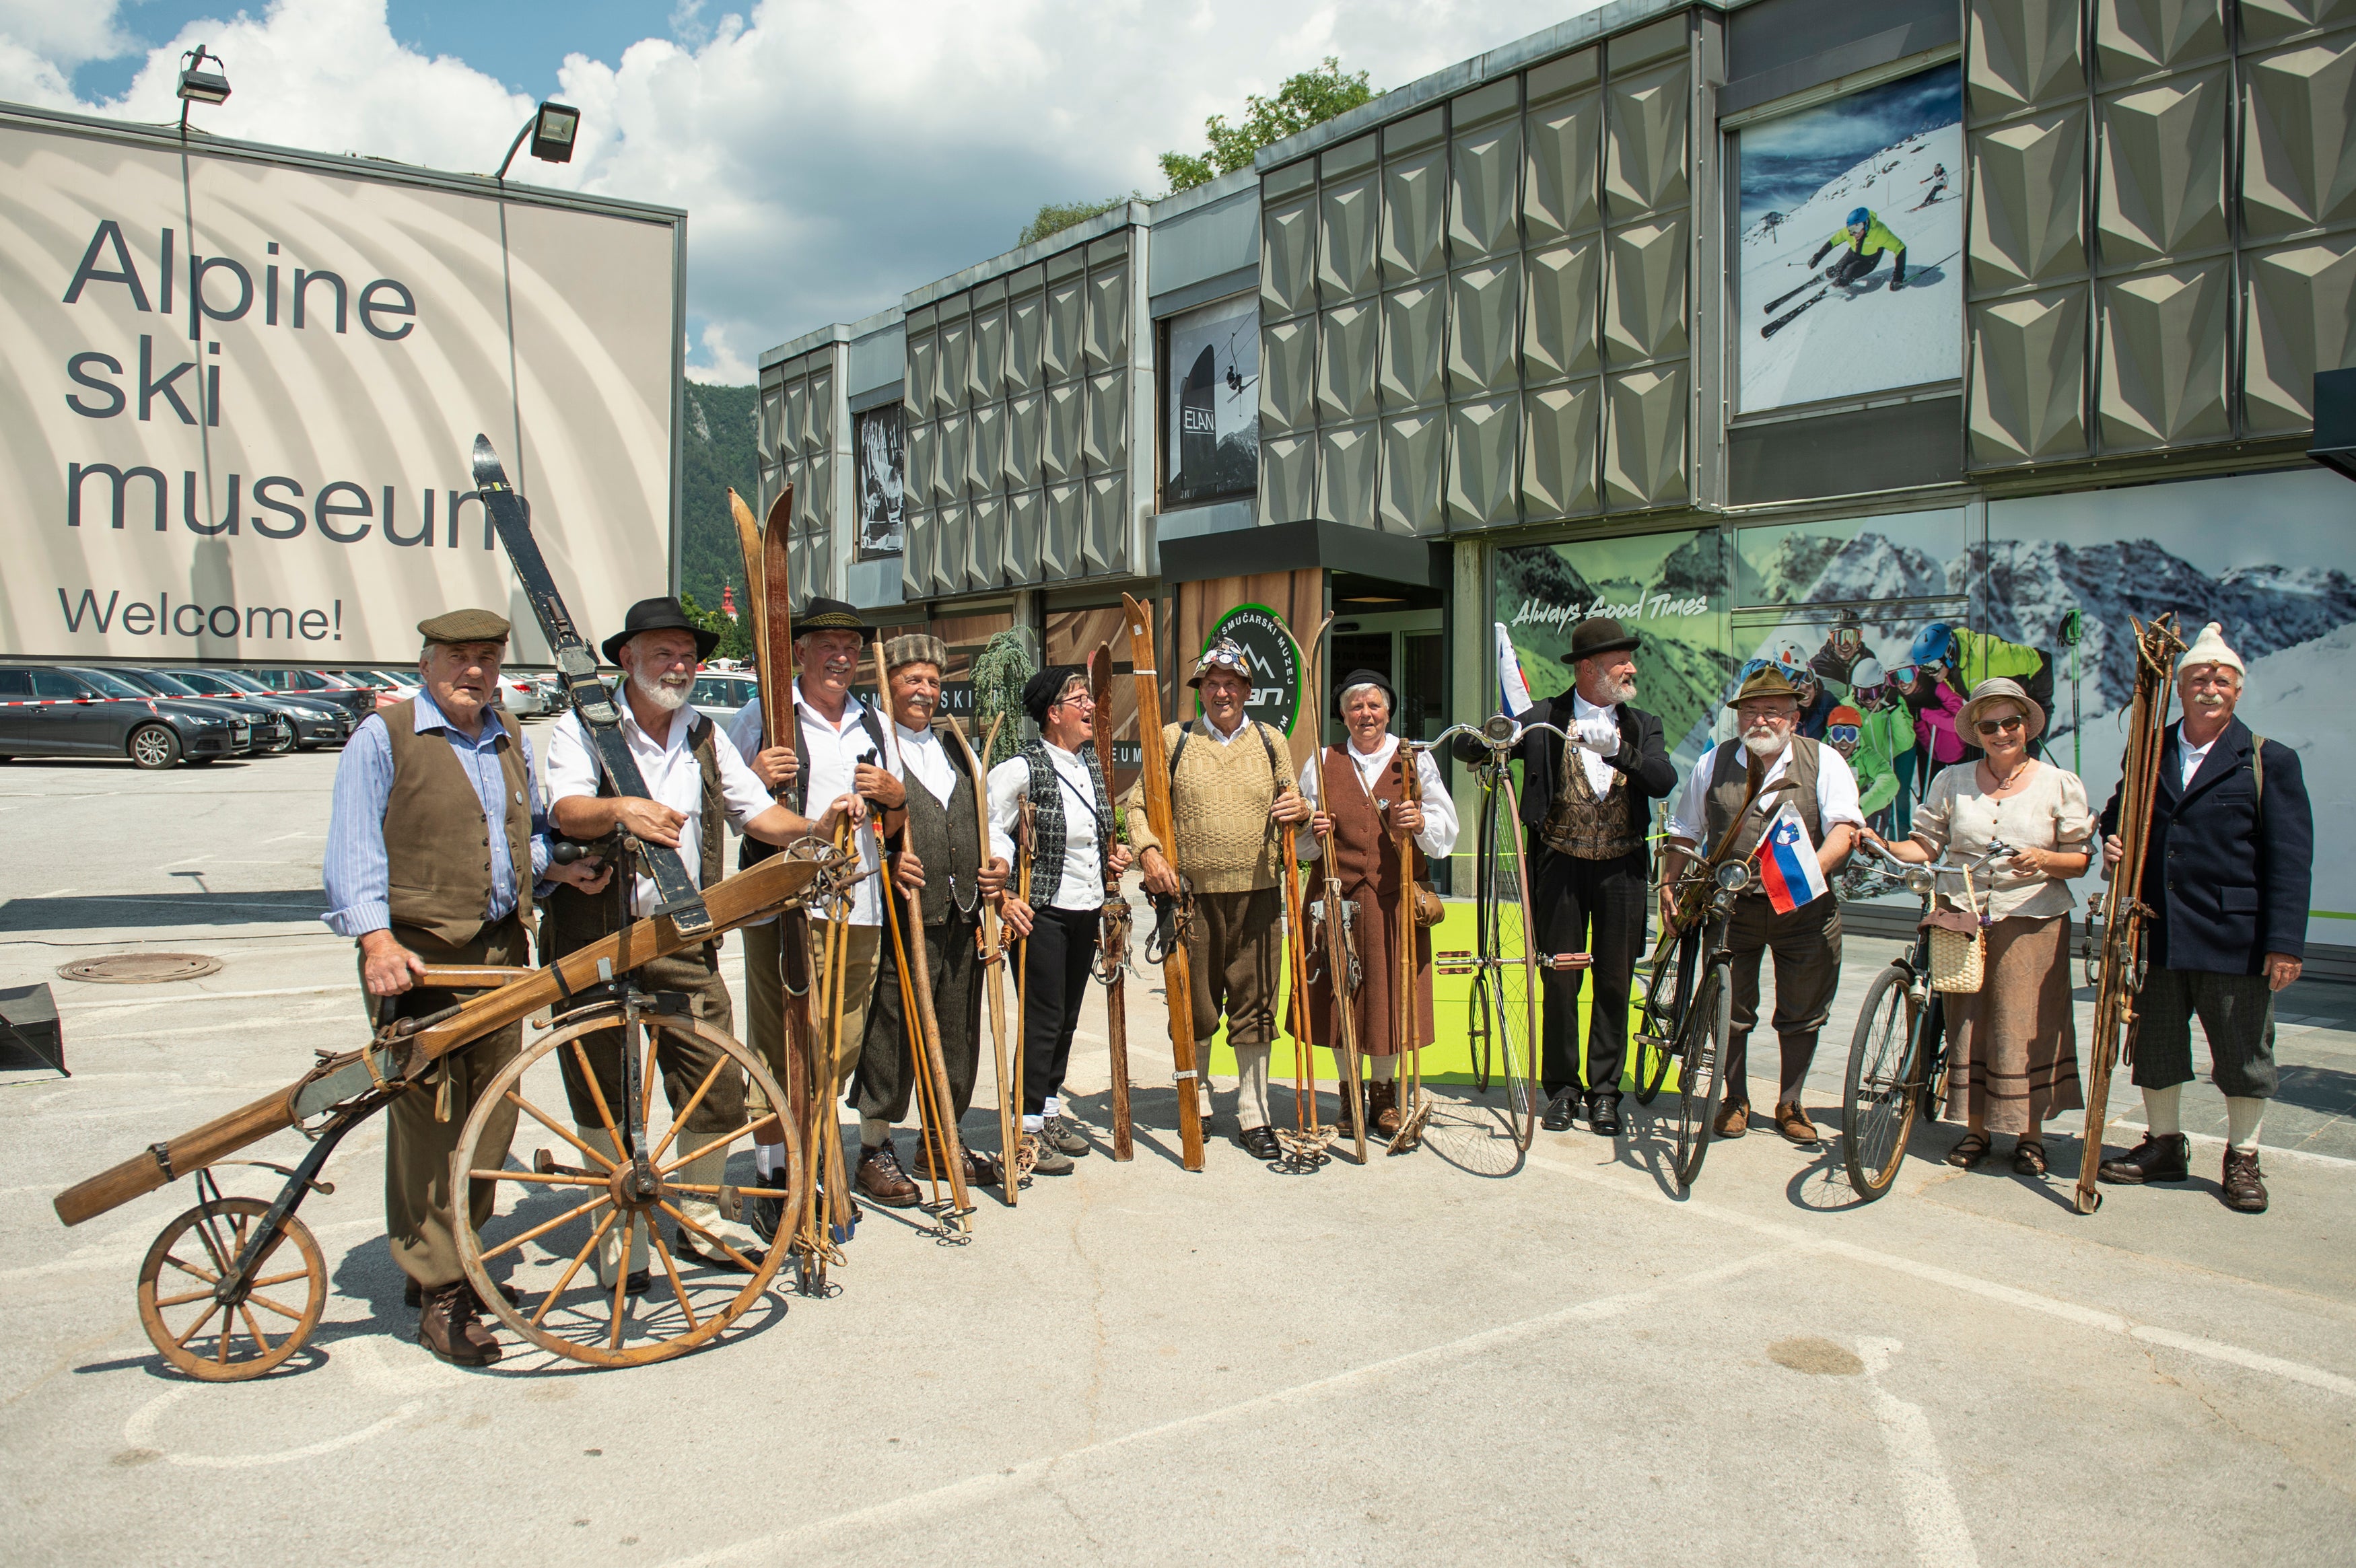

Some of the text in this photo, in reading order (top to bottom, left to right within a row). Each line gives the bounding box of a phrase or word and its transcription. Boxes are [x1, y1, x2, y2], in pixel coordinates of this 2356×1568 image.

[63, 220, 415, 341] Alpine
[66, 335, 219, 426] ski
[1185, 410, 1214, 431] ELAN
[68, 463, 530, 550] museum
[59, 588, 341, 641] Welcome!
[1221, 612, 1294, 685] SMUČARSKI MUZEJ
[1511, 590, 1708, 635] Always Good Times
